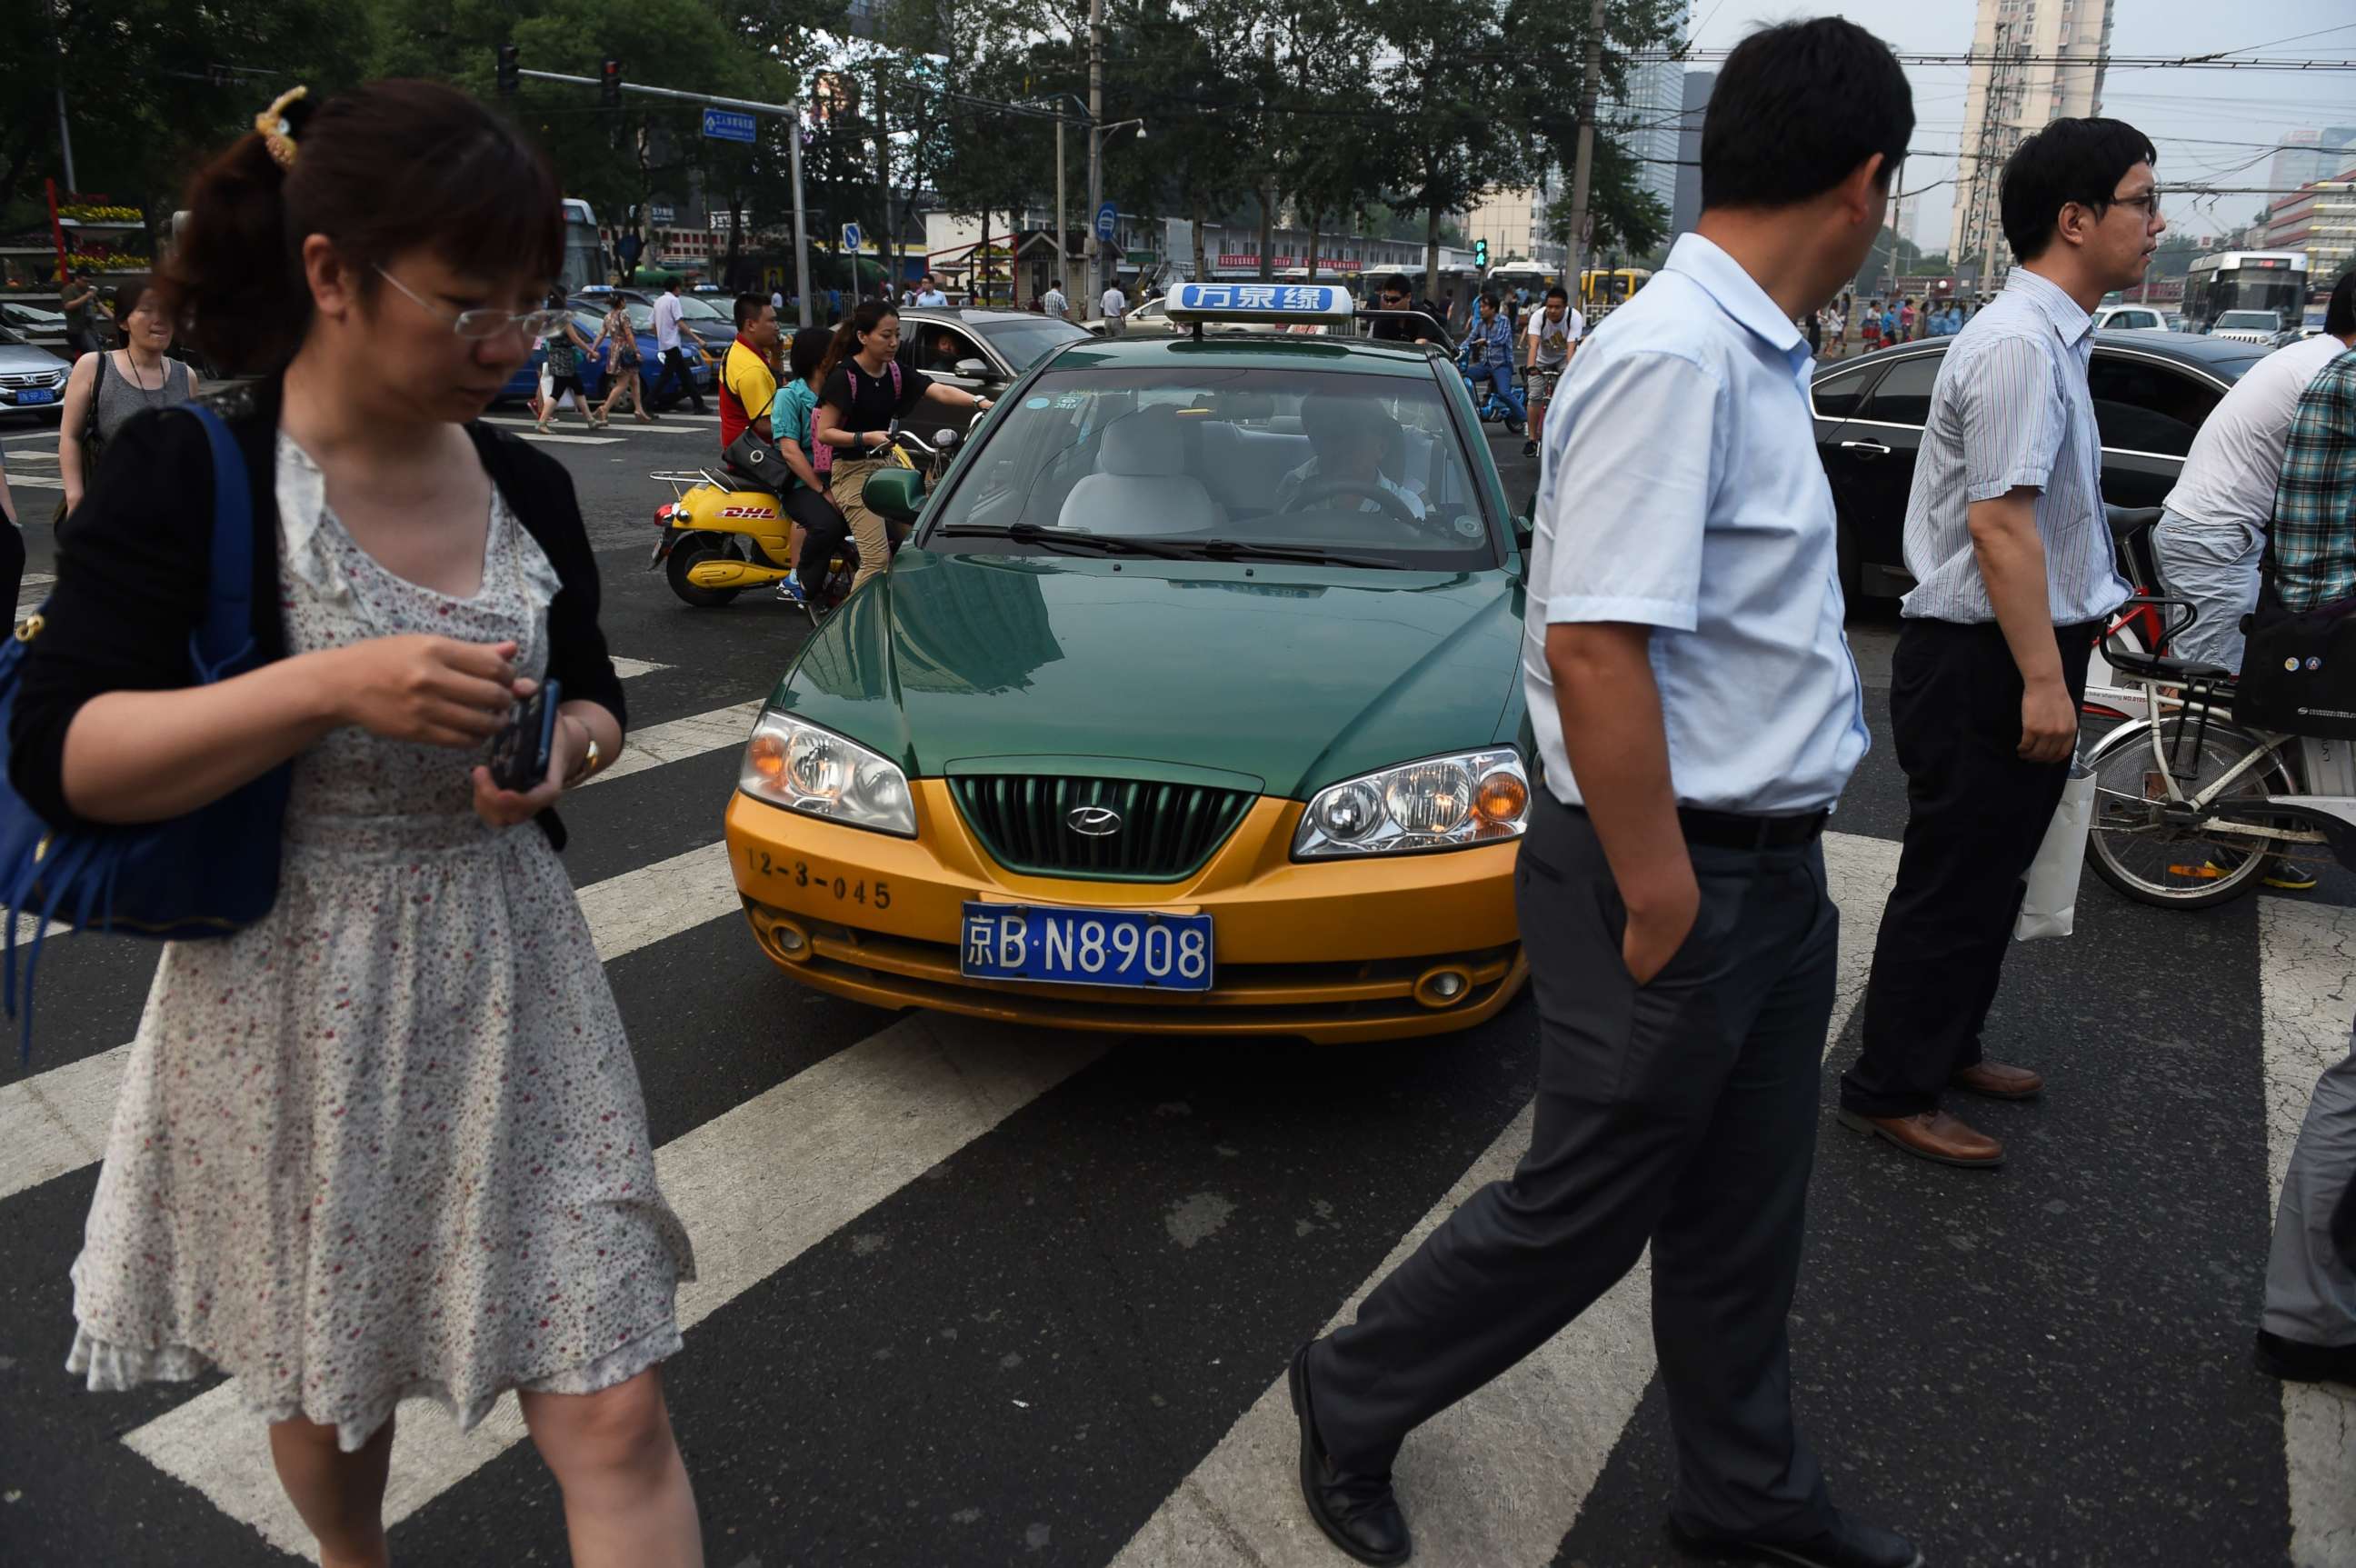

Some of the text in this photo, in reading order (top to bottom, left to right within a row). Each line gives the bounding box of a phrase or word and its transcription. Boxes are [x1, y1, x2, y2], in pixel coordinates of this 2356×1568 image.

[1193, 286, 1321, 309] 万泉缘
[724, 507, 775, 519] DHL
[747, 848, 891, 910] 12-3-045
[968, 914, 1206, 979] 京B·N8908
